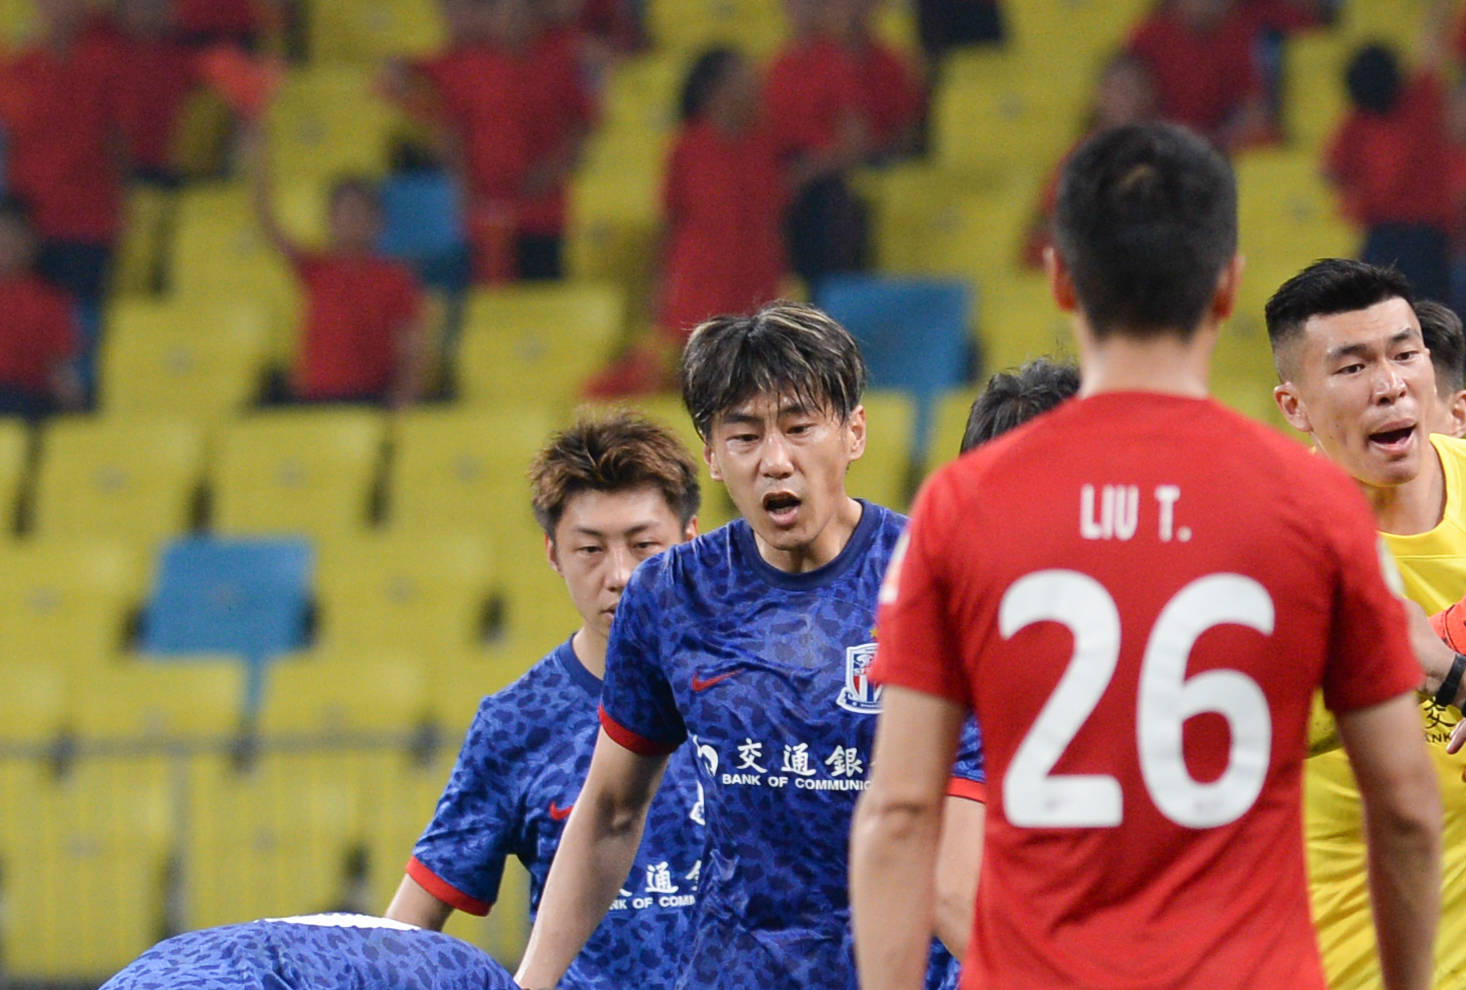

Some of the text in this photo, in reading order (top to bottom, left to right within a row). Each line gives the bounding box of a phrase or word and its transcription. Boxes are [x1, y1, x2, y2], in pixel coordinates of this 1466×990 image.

[1080, 483, 1192, 542] LIU T.
[998, 568, 1275, 829] 26
[736, 737, 876, 777] 交通銀
[722, 773, 761, 786] BANK
[768, 776, 788, 788] OF
[632, 897, 653, 909] OF
